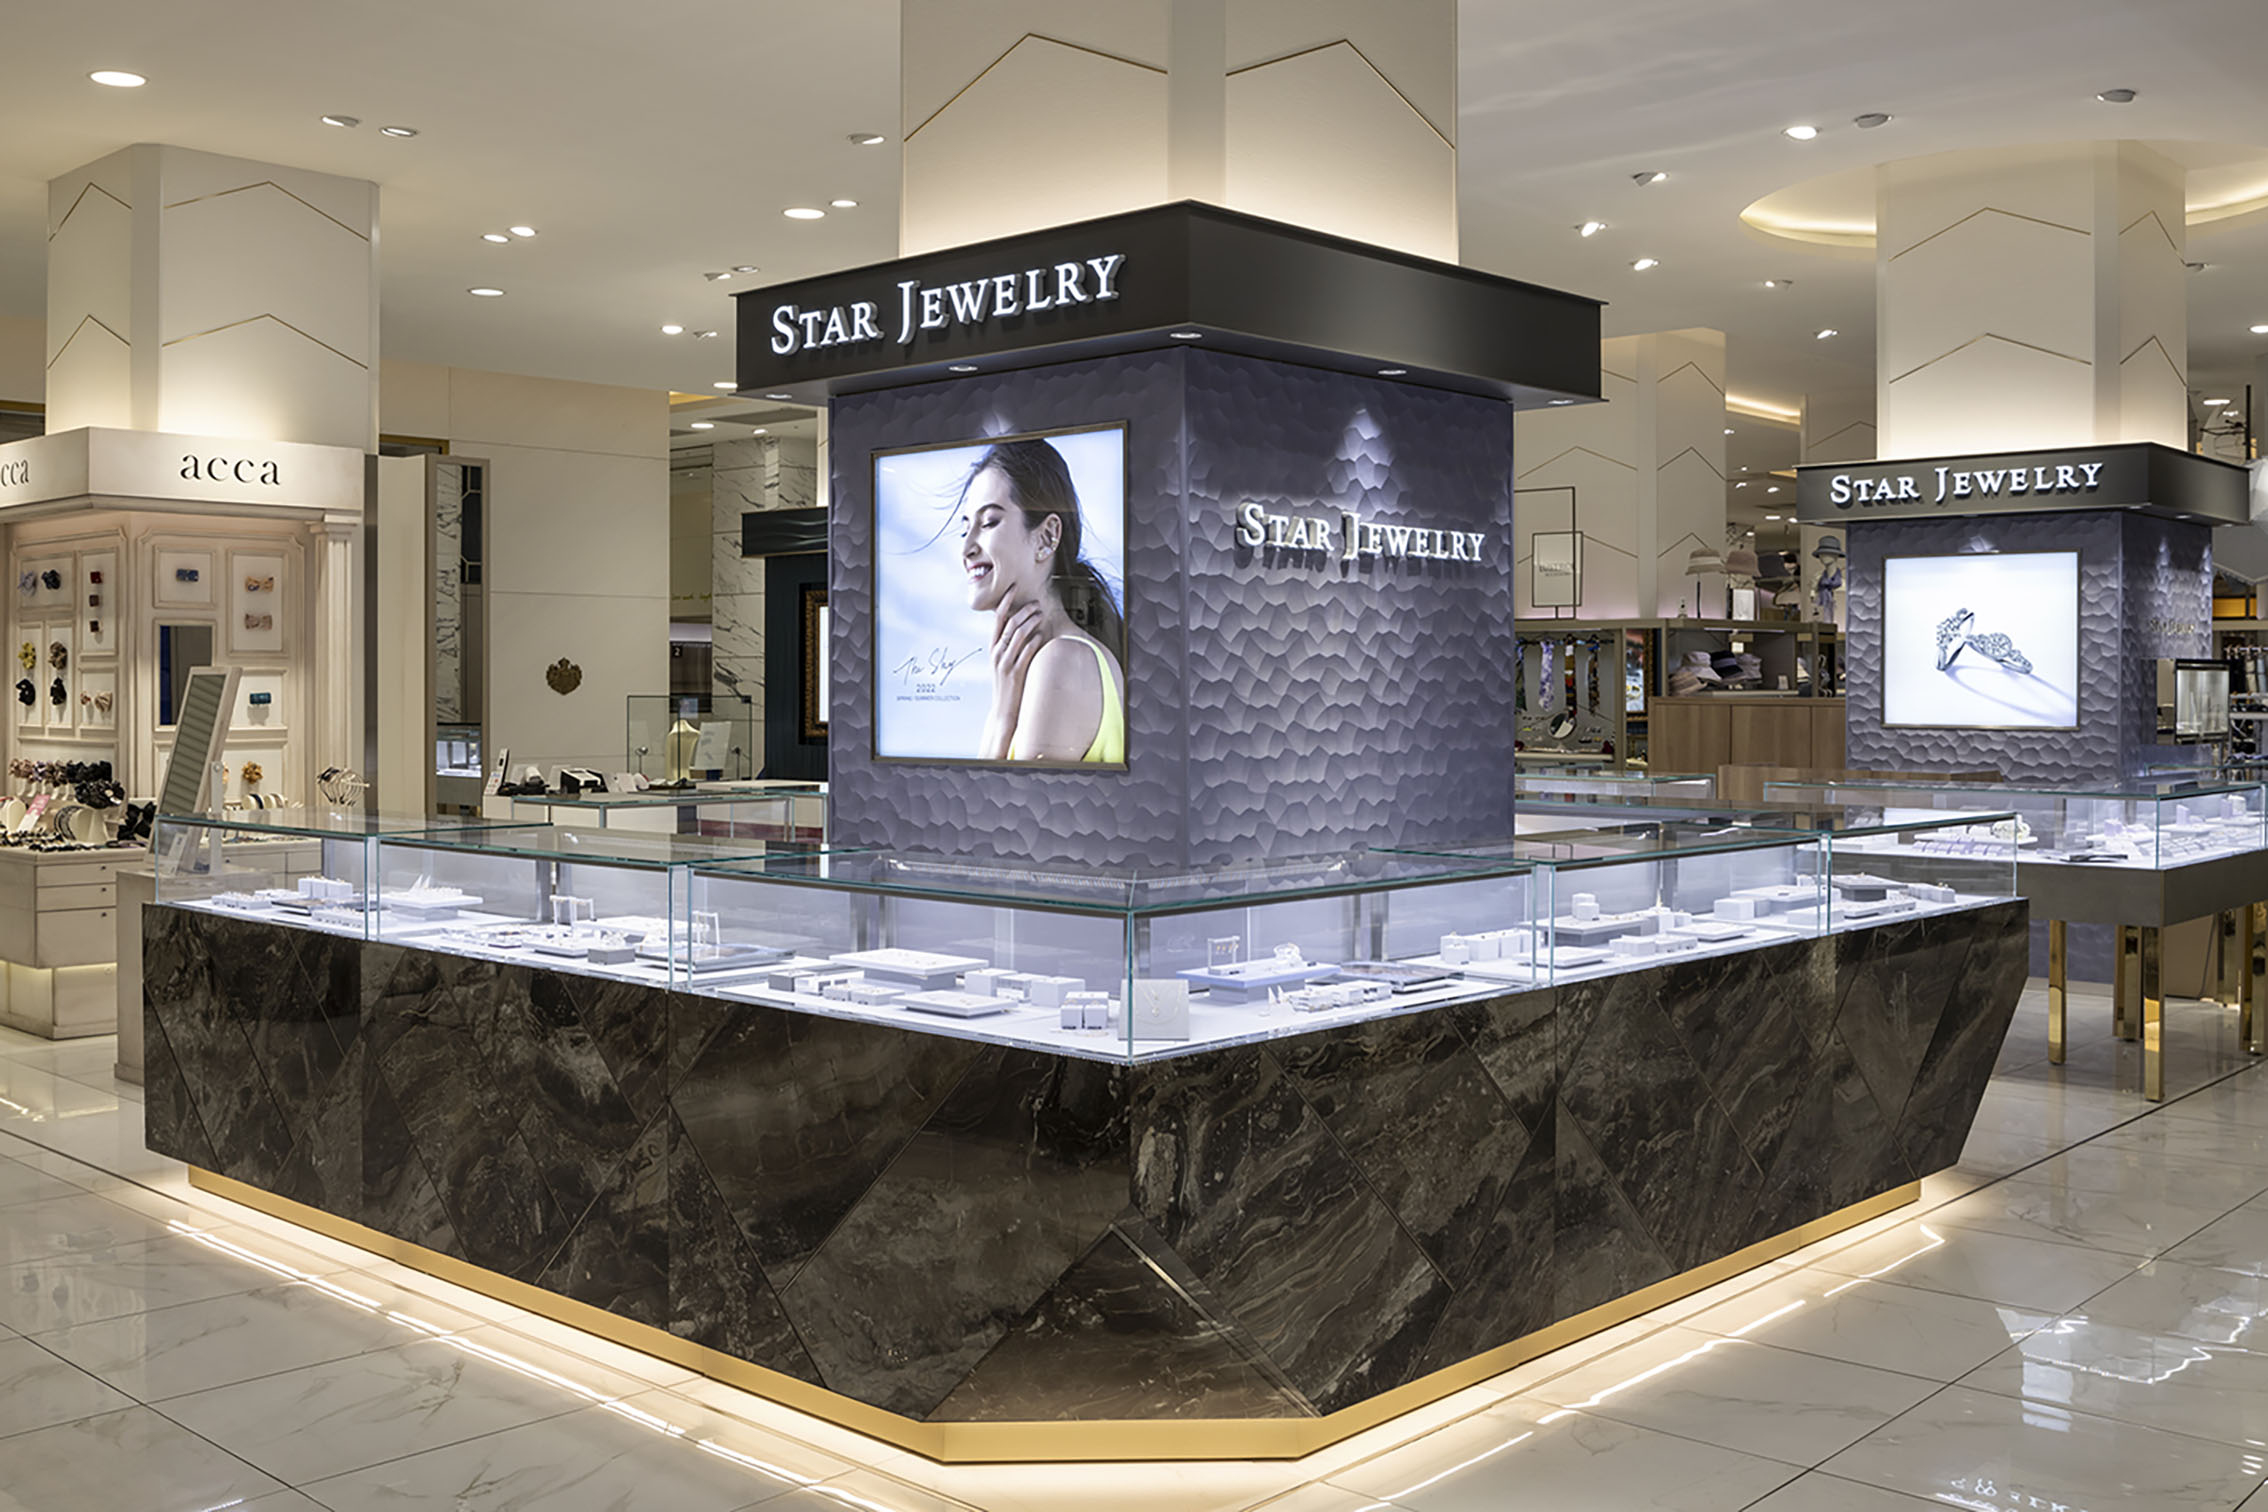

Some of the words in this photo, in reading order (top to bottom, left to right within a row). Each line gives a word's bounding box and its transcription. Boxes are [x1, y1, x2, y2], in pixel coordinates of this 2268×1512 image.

[771, 304, 882, 356] STAR
[897, 254, 1125, 344] JEWELRY
[180, 454, 281, 485] acca
[1830, 475, 1920, 503] STAR
[1934, 463, 2103, 501] JEWELRY
[1236, 503, 1334, 551] STAR
[1342, 511, 1486, 561] JEWELRY
